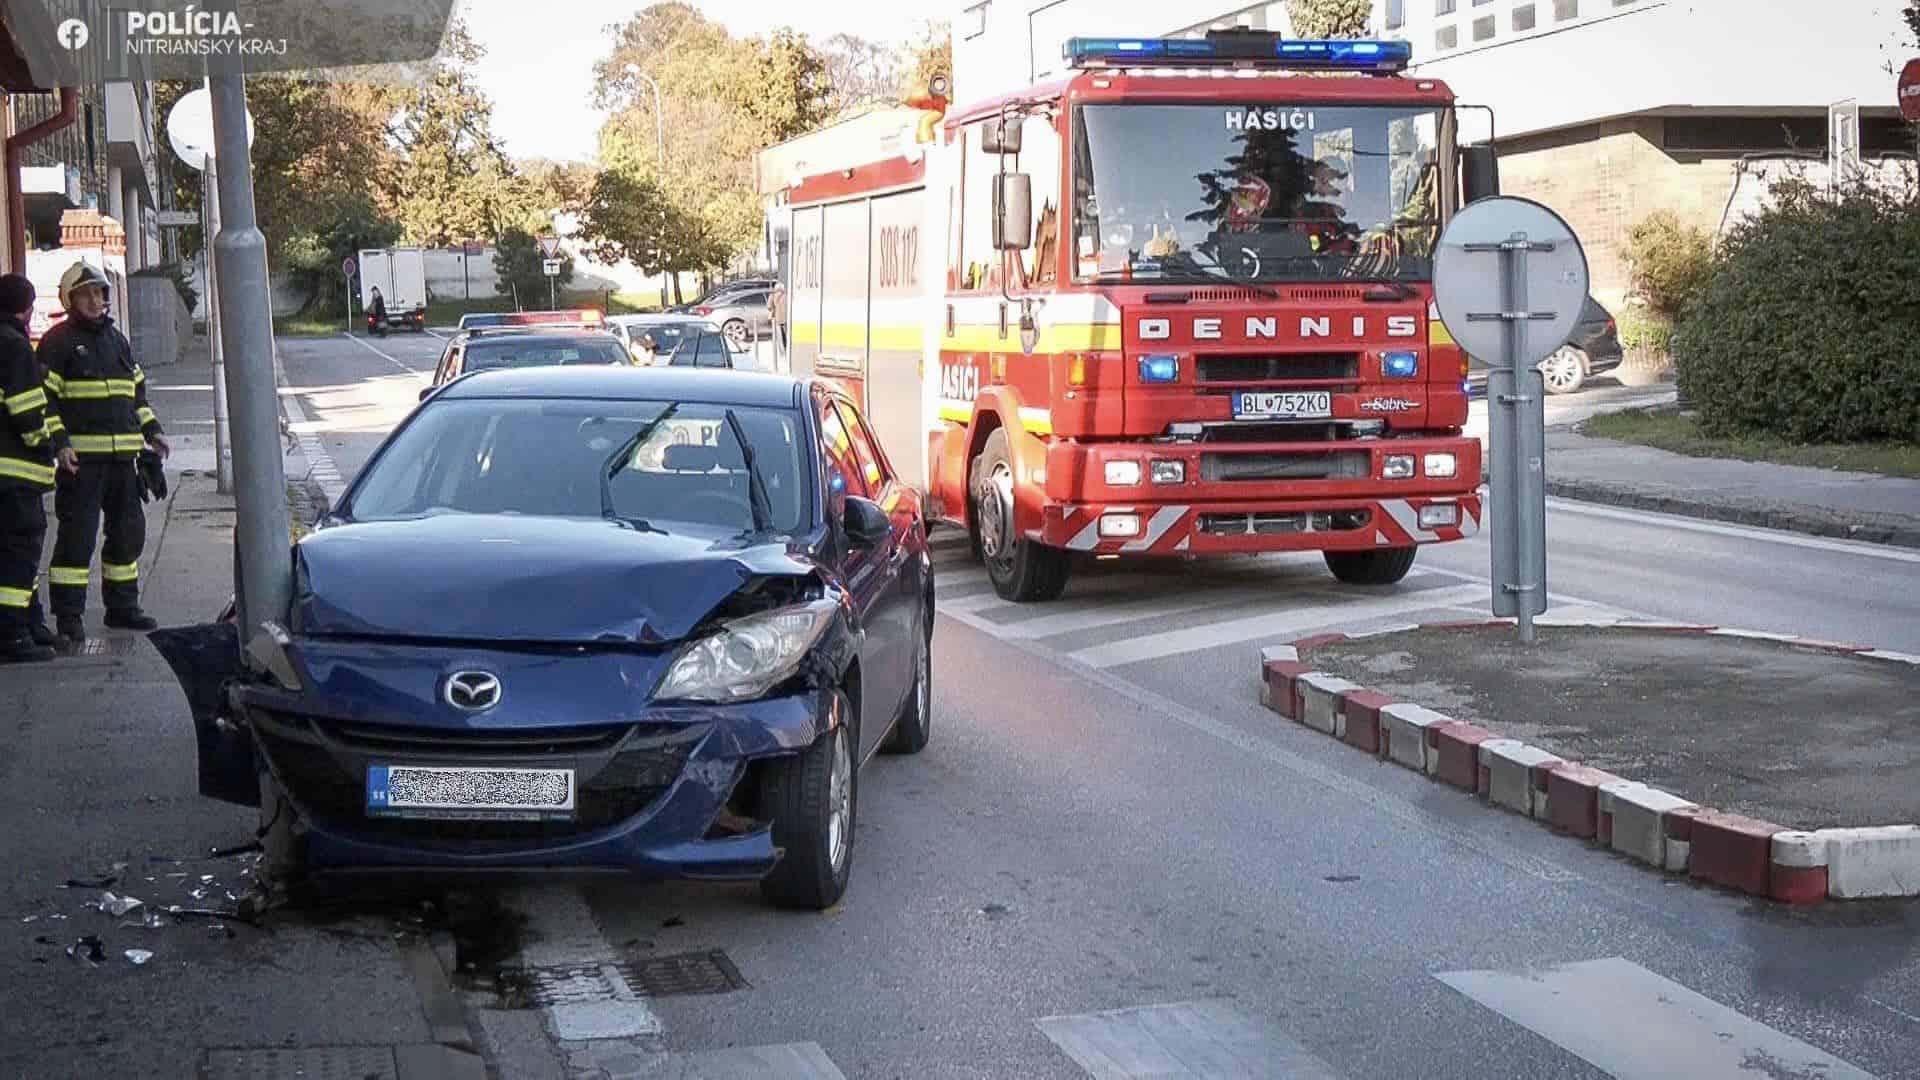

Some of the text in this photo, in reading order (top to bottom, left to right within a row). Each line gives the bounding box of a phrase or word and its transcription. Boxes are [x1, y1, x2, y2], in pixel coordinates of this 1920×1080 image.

[1225, 107, 1315, 130] HASIČI
[879, 224, 919, 288] SOS 112
[1138, 316, 1417, 340] DENNIS
